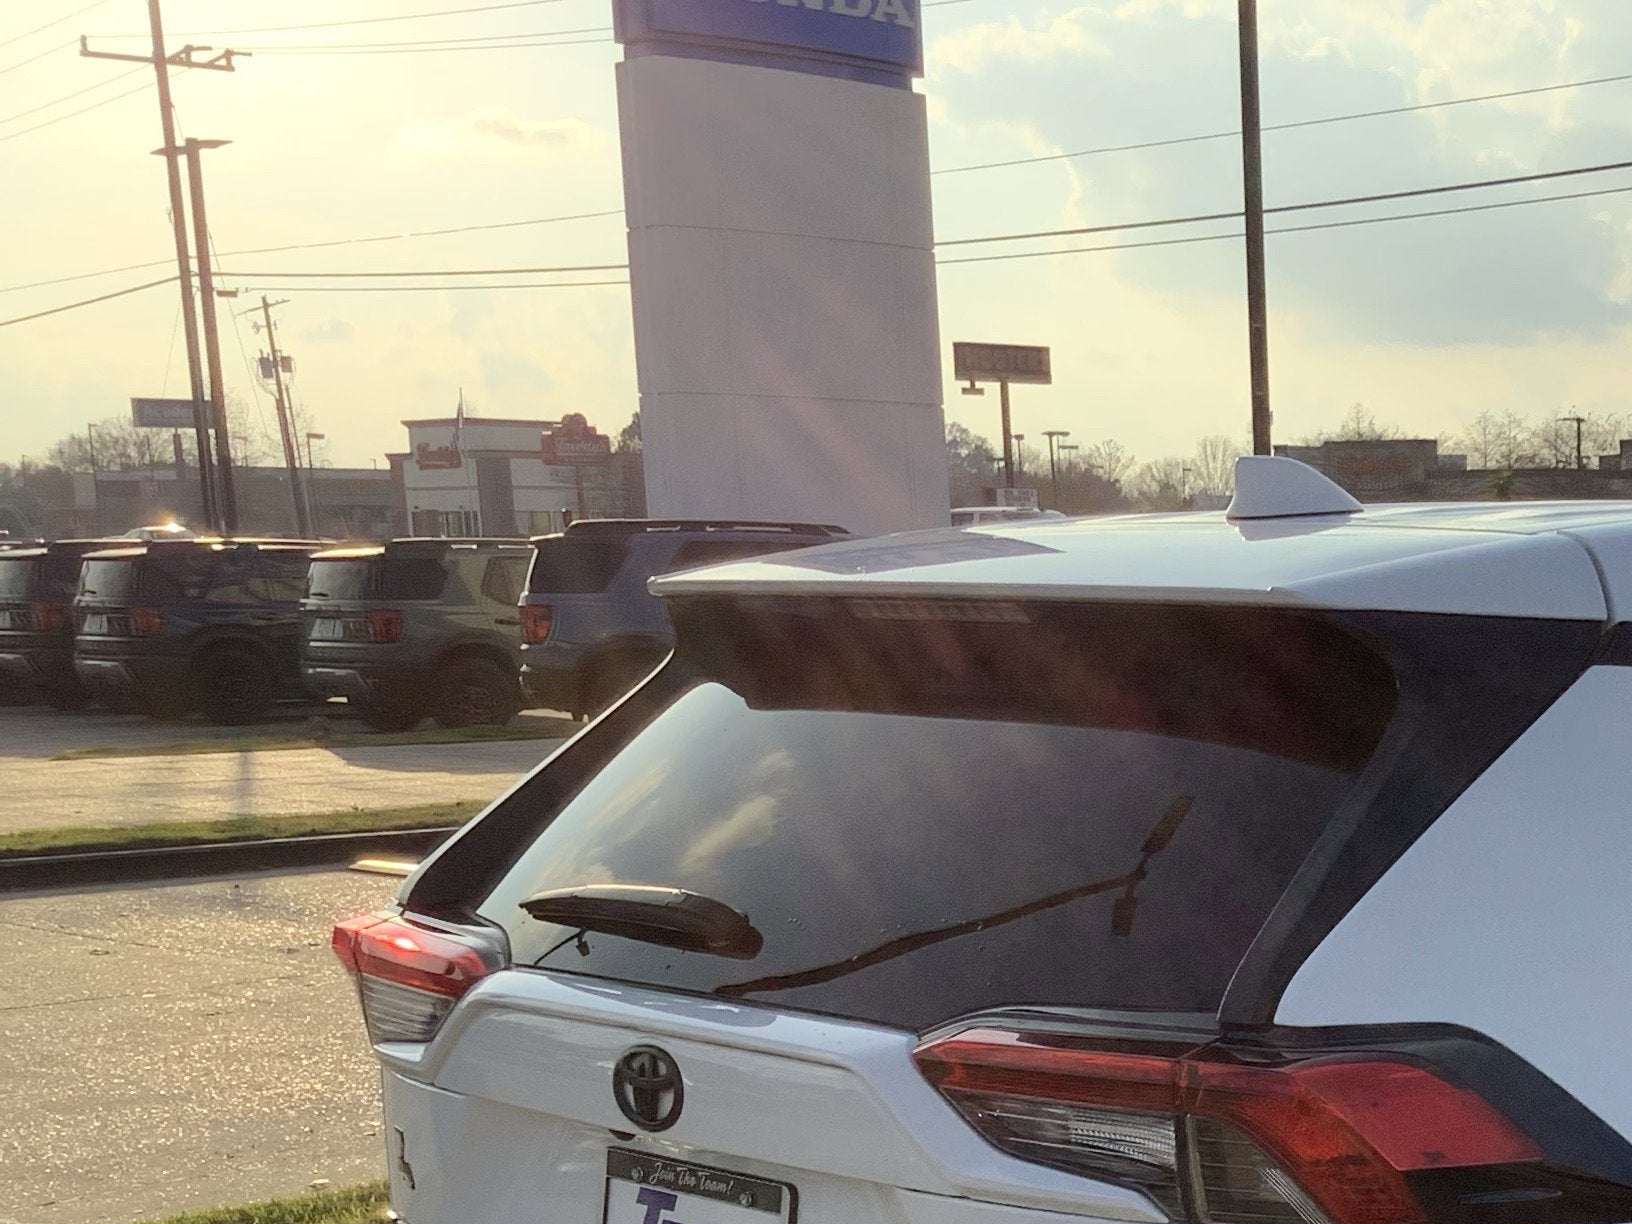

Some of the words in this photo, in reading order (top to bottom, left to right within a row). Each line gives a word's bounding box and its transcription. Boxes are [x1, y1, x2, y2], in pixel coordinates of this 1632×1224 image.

[649, 1162, 676, 1185] Join
[677, 1167, 697, 1187] The
[698, 1171, 735, 1196] Team!
